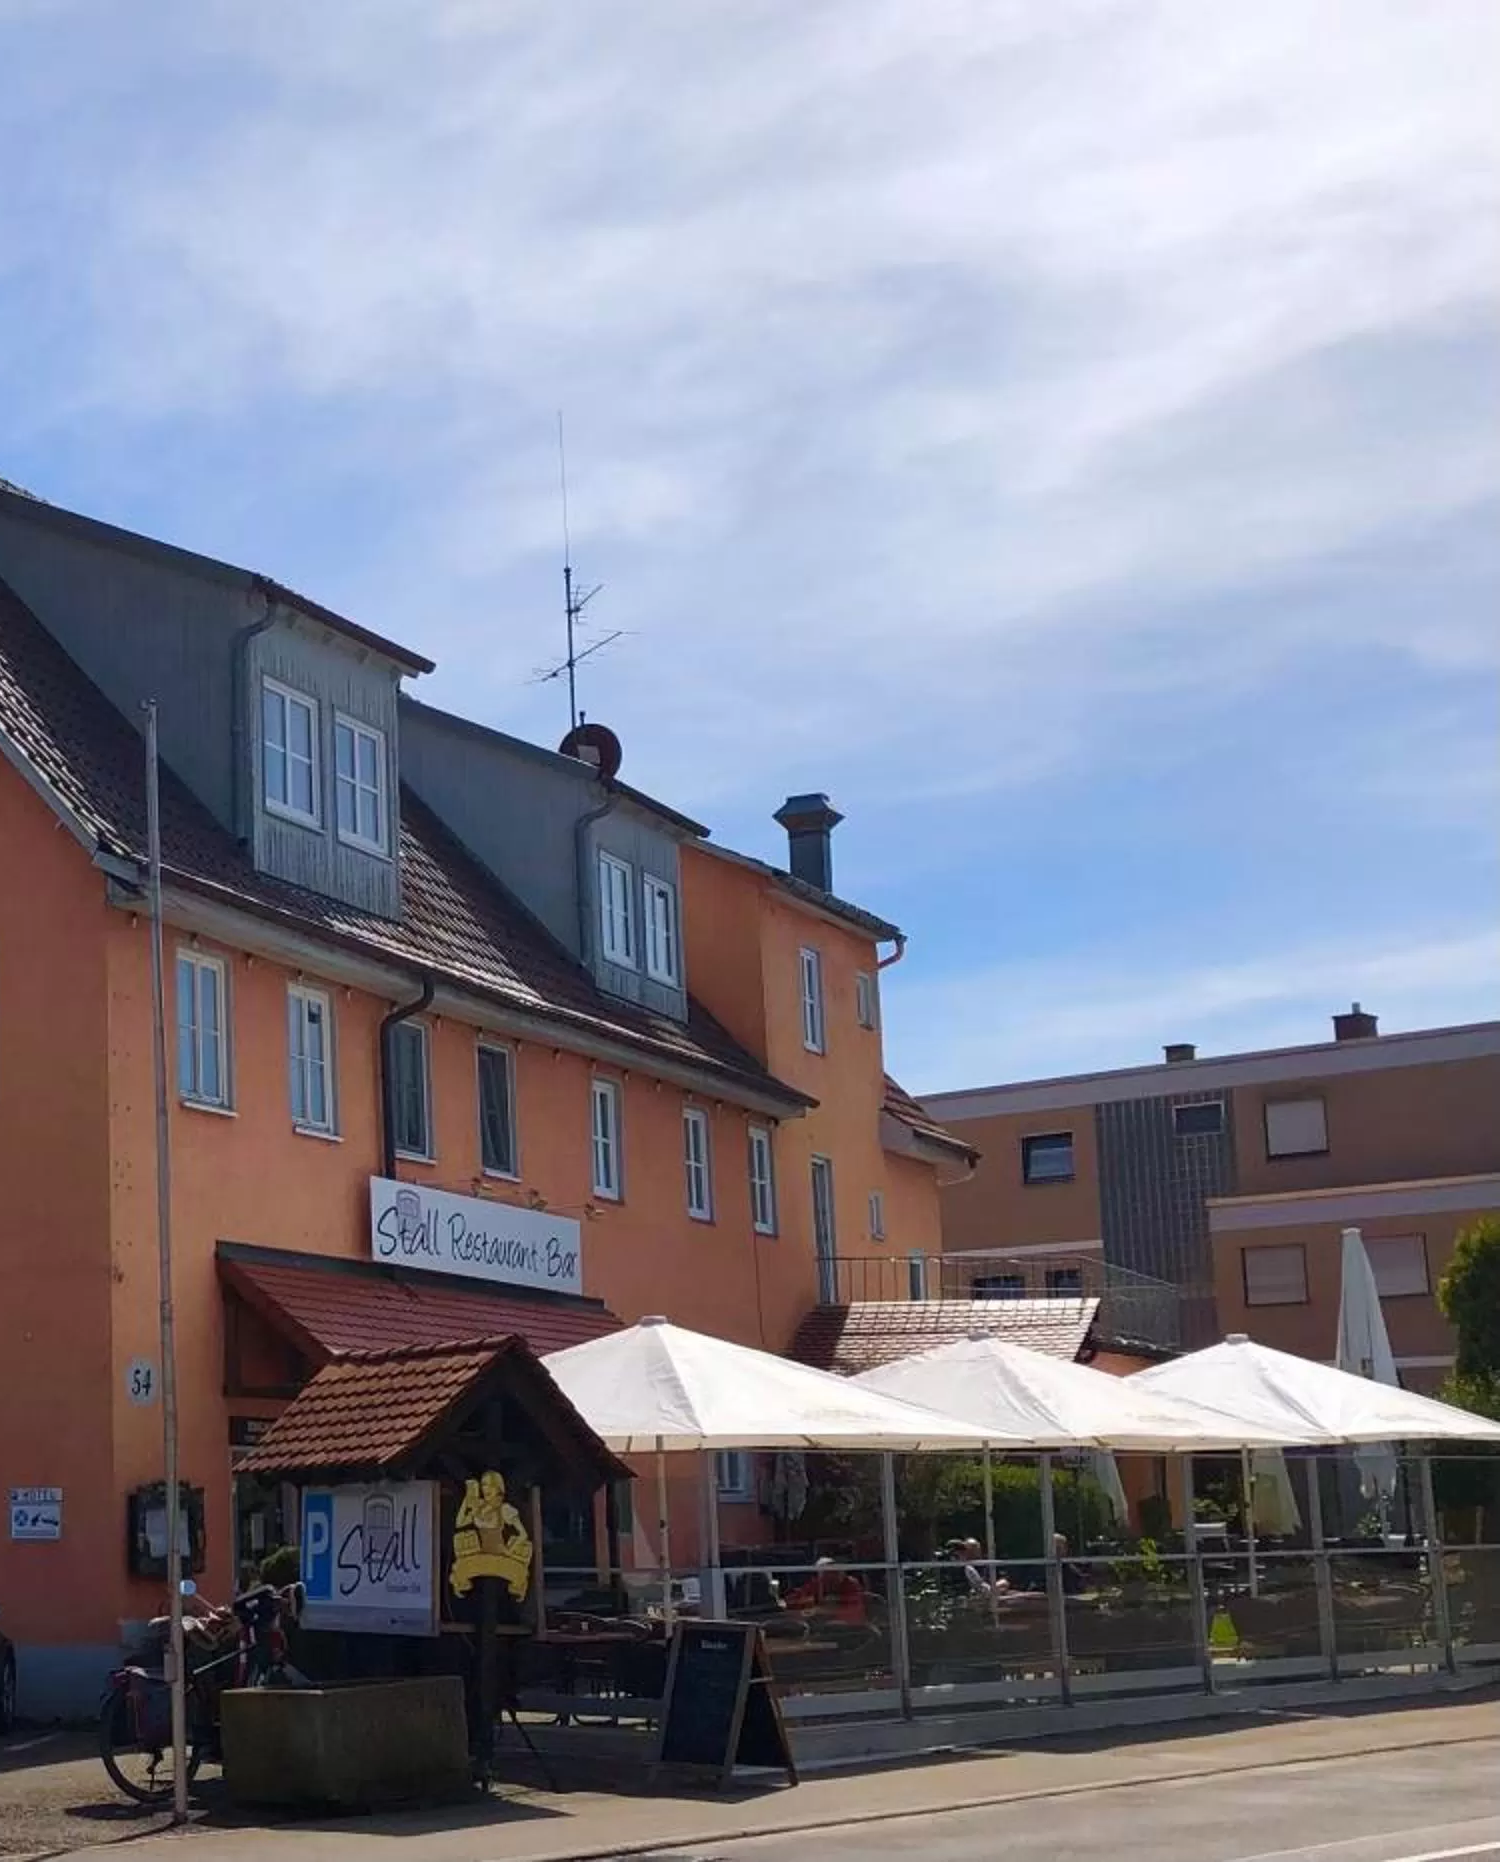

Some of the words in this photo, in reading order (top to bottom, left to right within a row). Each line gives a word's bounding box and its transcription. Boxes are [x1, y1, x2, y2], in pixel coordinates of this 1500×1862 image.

[377, 1206, 442, 1257] Stall
[545, 1237, 578, 1278] Bar
[131, 1368, 152, 1396] 54
[306, 1511, 330, 1581] P
[337, 1503, 421, 1596] Stall
